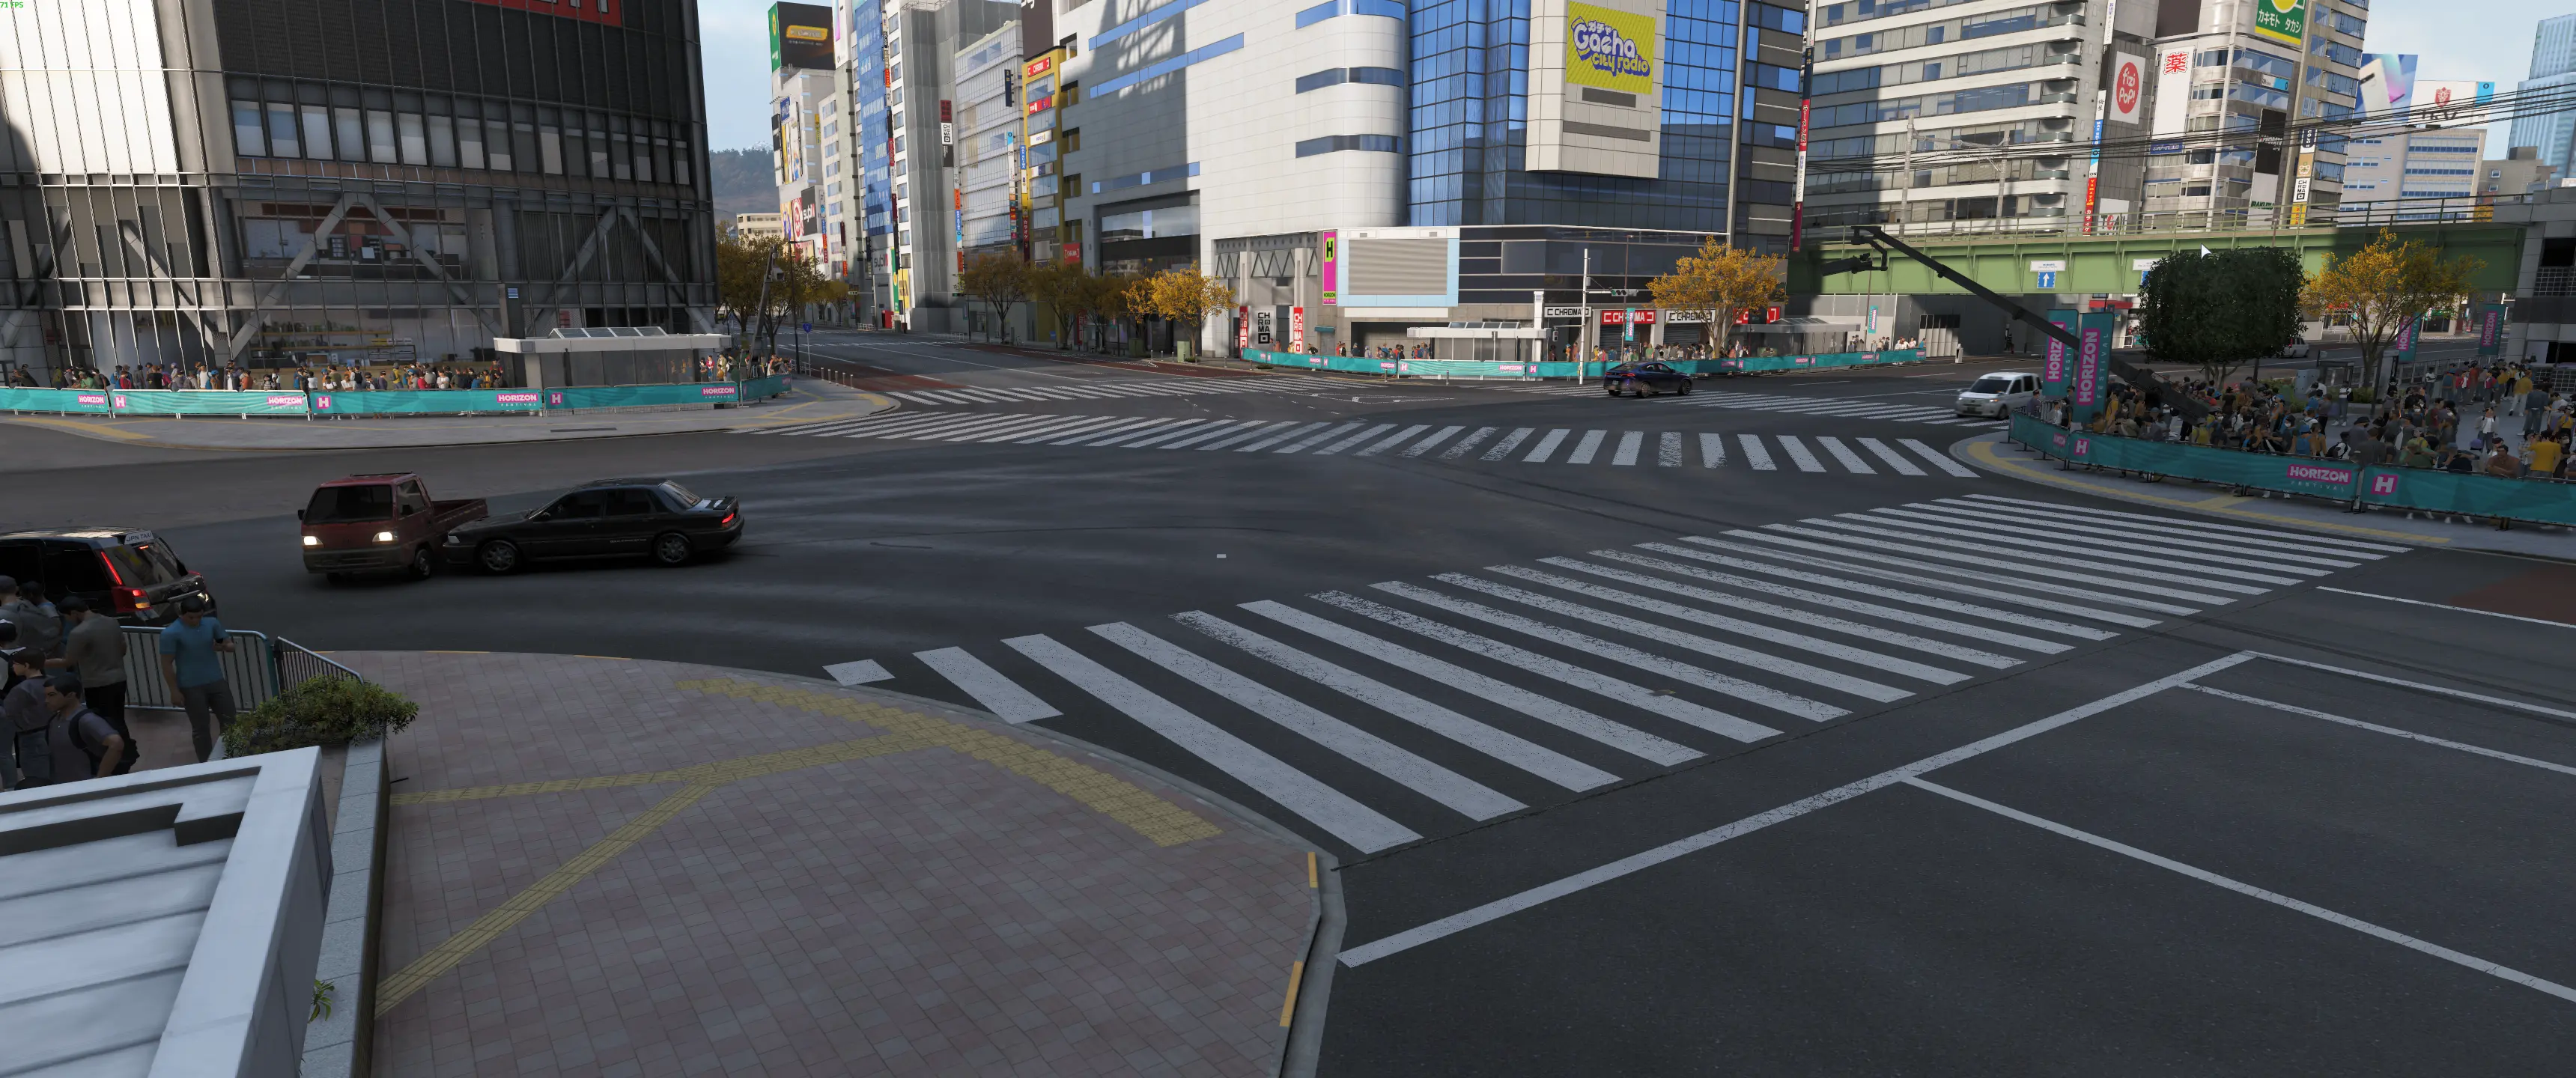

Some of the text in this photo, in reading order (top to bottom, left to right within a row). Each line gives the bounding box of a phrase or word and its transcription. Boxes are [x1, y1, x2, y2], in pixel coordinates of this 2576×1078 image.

[1588, 21, 1612, 34] ガチャ
[2258, 8, 2302, 34] カキモト タカシ
[1574, 23, 1635, 58] Gacha
[1592, 52, 1648, 73] city radio
[2165, 52, 2187, 73] 薬
[2122, 67, 2136, 87] fizi
[1326, 241, 1333, 258] H
[1294, 313, 1302, 322] CH
[1240, 328, 1247, 336] MA
[1294, 331, 1302, 340] MA
[2482, 312, 2496, 345] HORIZON
[2080, 332, 2097, 402] HORIZON
[2097, 333, 2109, 398] FESTIVAL
[79, 395, 104, 404] HORIZON
[115, 397, 125, 407] H
[318, 398, 329, 407] H
[551, 394, 561, 403] H
[2076, 440, 2087, 454] H
[2290, 466, 2348, 483] HORIZON
[2375, 476, 2394, 493] H
